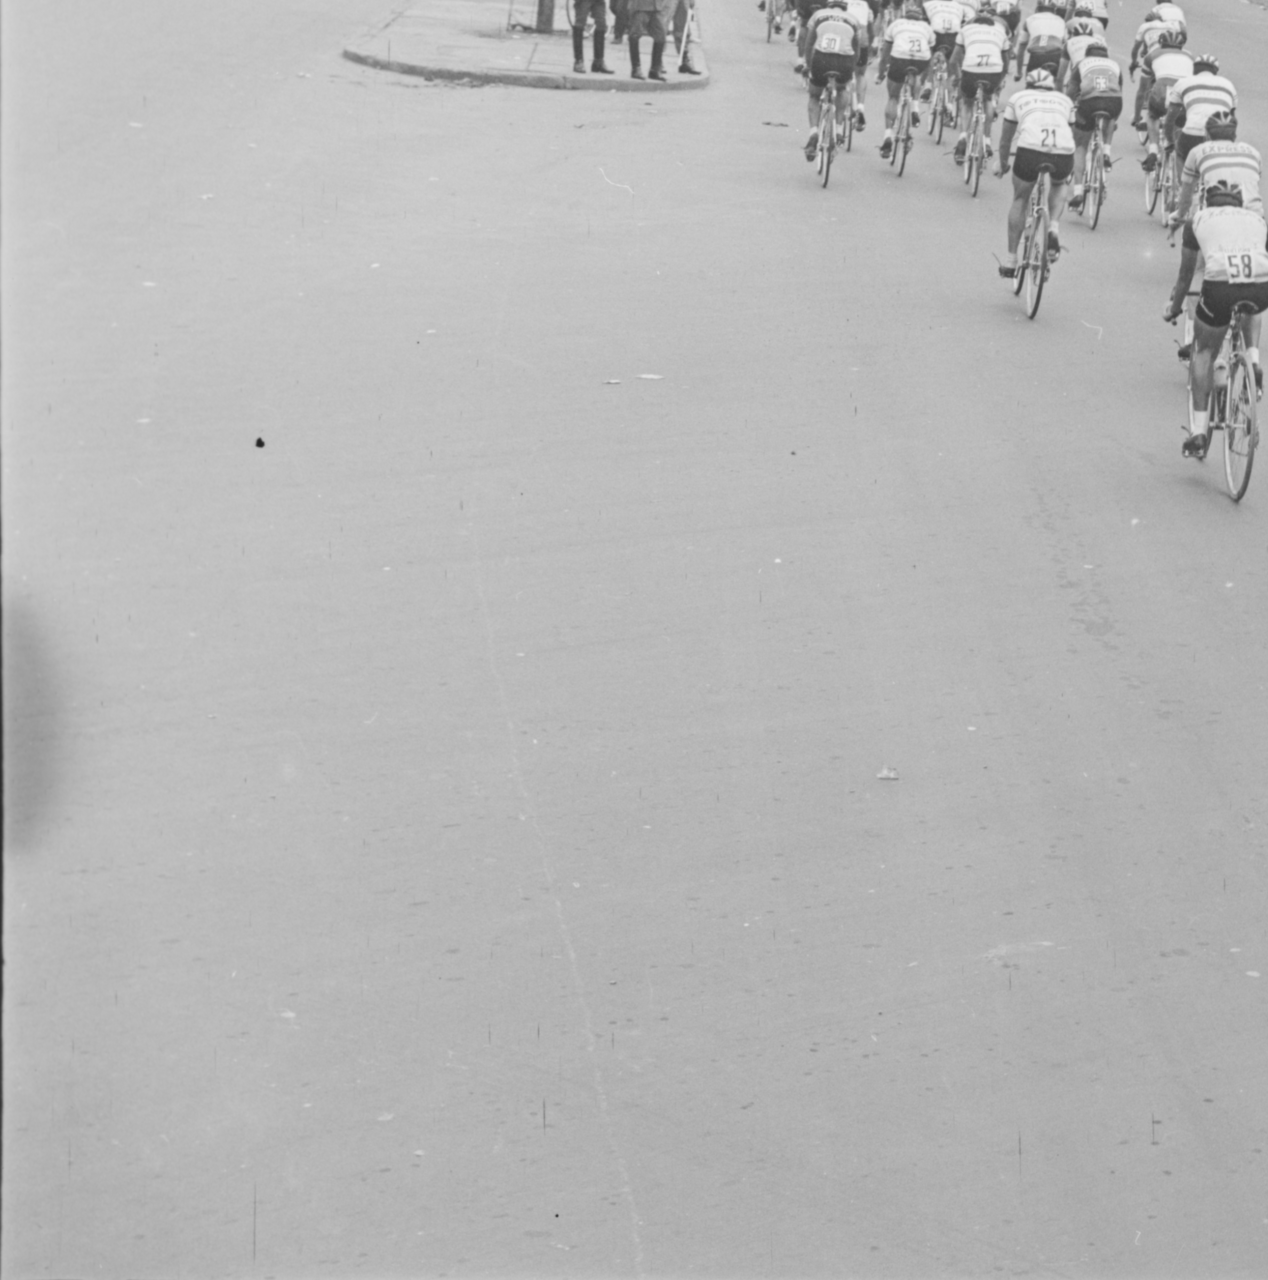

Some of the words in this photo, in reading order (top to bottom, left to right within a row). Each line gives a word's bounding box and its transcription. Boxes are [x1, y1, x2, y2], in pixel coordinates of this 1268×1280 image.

[908, 39, 922, 53] 23
[976, 53, 990, 68] 27
[1041, 128, 1057, 148] 21
[1227, 253, 1252, 279] 58
